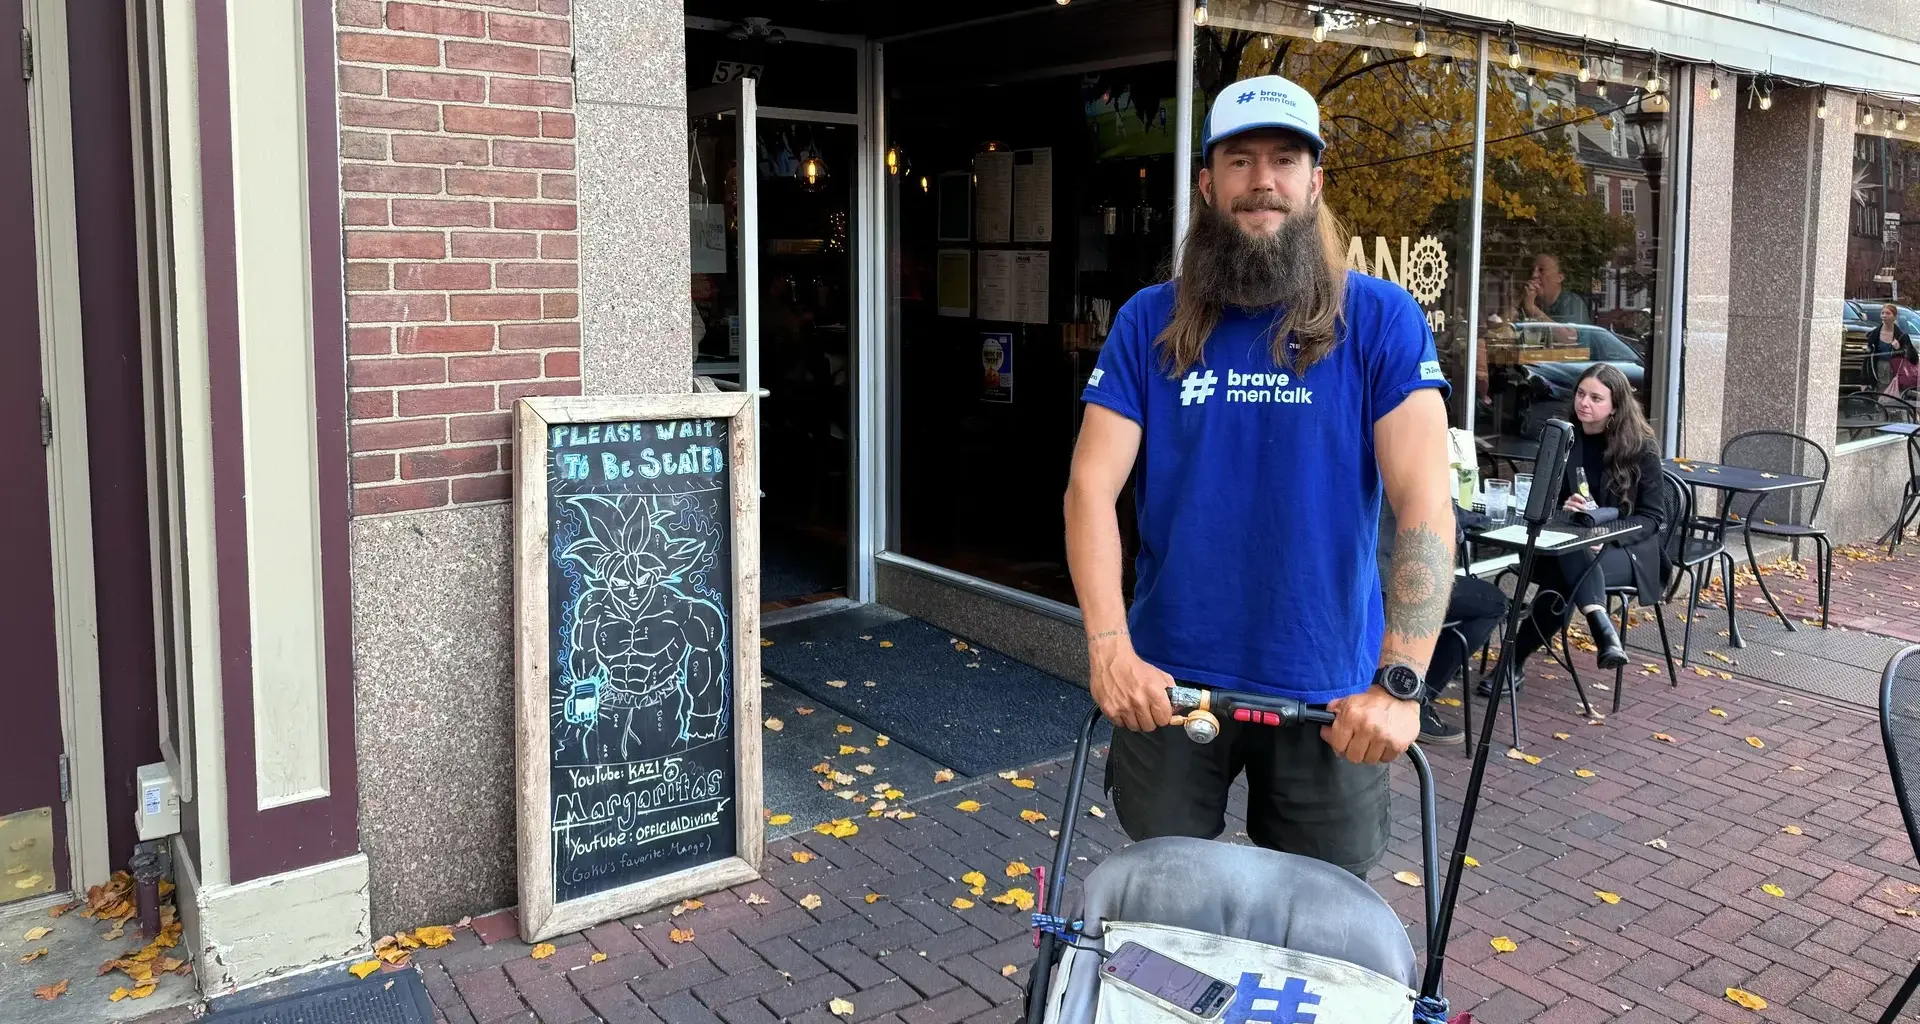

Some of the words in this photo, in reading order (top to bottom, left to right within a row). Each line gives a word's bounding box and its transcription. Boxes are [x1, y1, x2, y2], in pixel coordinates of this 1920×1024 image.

[716, 62, 761, 87] 526
[1260, 89, 1287, 99] brave
[1281, 98, 1296, 107] talk
[1227, 368, 1290, 387] brave
[1226, 388, 1271, 403] men
[1274, 386, 1313, 404] talk
[551, 423, 642, 448] PLEASE
[628, 760, 660, 780] KAZI
[553, 769, 722, 832] Margaritas
